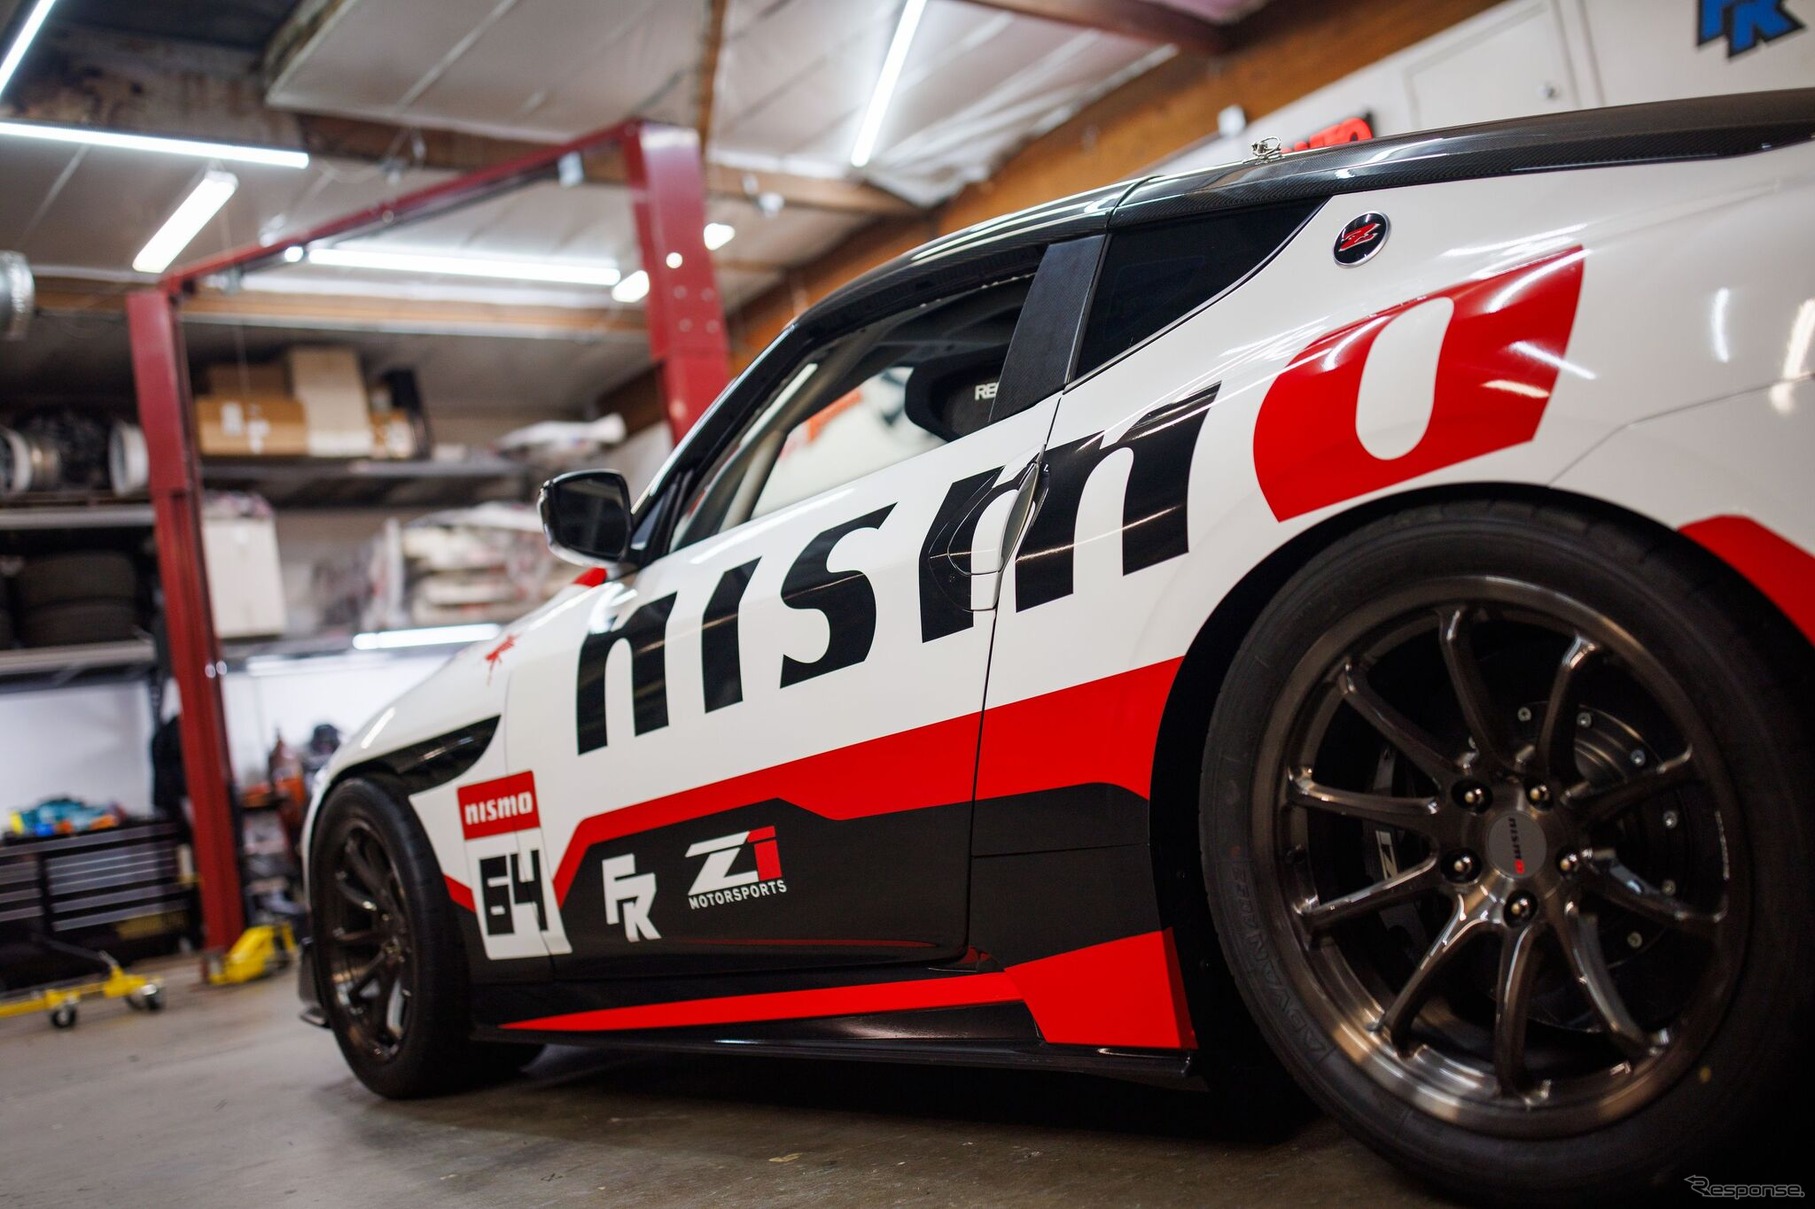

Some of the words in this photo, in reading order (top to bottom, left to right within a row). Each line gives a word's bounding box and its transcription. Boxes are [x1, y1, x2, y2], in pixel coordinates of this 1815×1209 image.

[974, 381, 999, 401] RE
[576, 247, 1583, 754] nismo
[479, 849, 549, 936] 64
[688, 879, 787, 910] MOTORSPORTS
